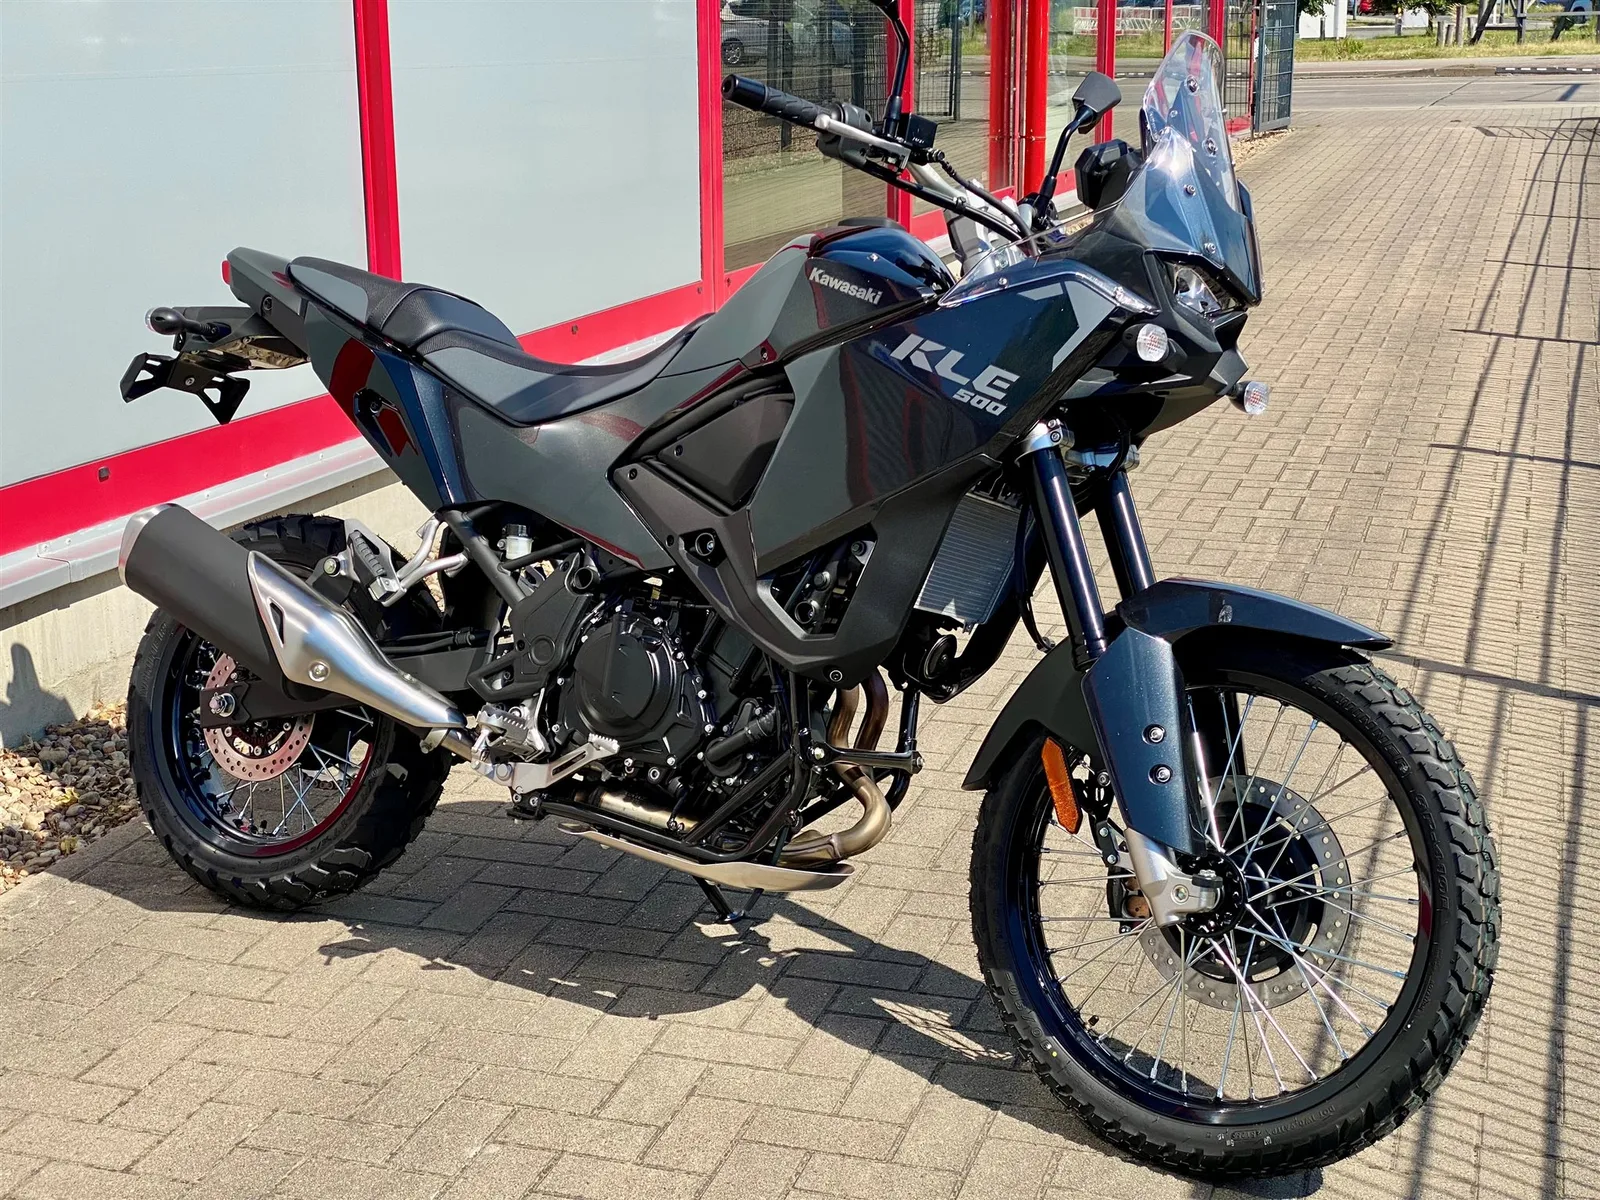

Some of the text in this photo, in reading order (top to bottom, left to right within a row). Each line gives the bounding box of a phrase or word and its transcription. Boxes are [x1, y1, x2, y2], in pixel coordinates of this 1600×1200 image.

[808, 267, 882, 305] Kawasaki
[890, 333, 1020, 400] KLE
[952, 389, 1007, 416] 500
[1336, 691, 1412, 775] WINNER
